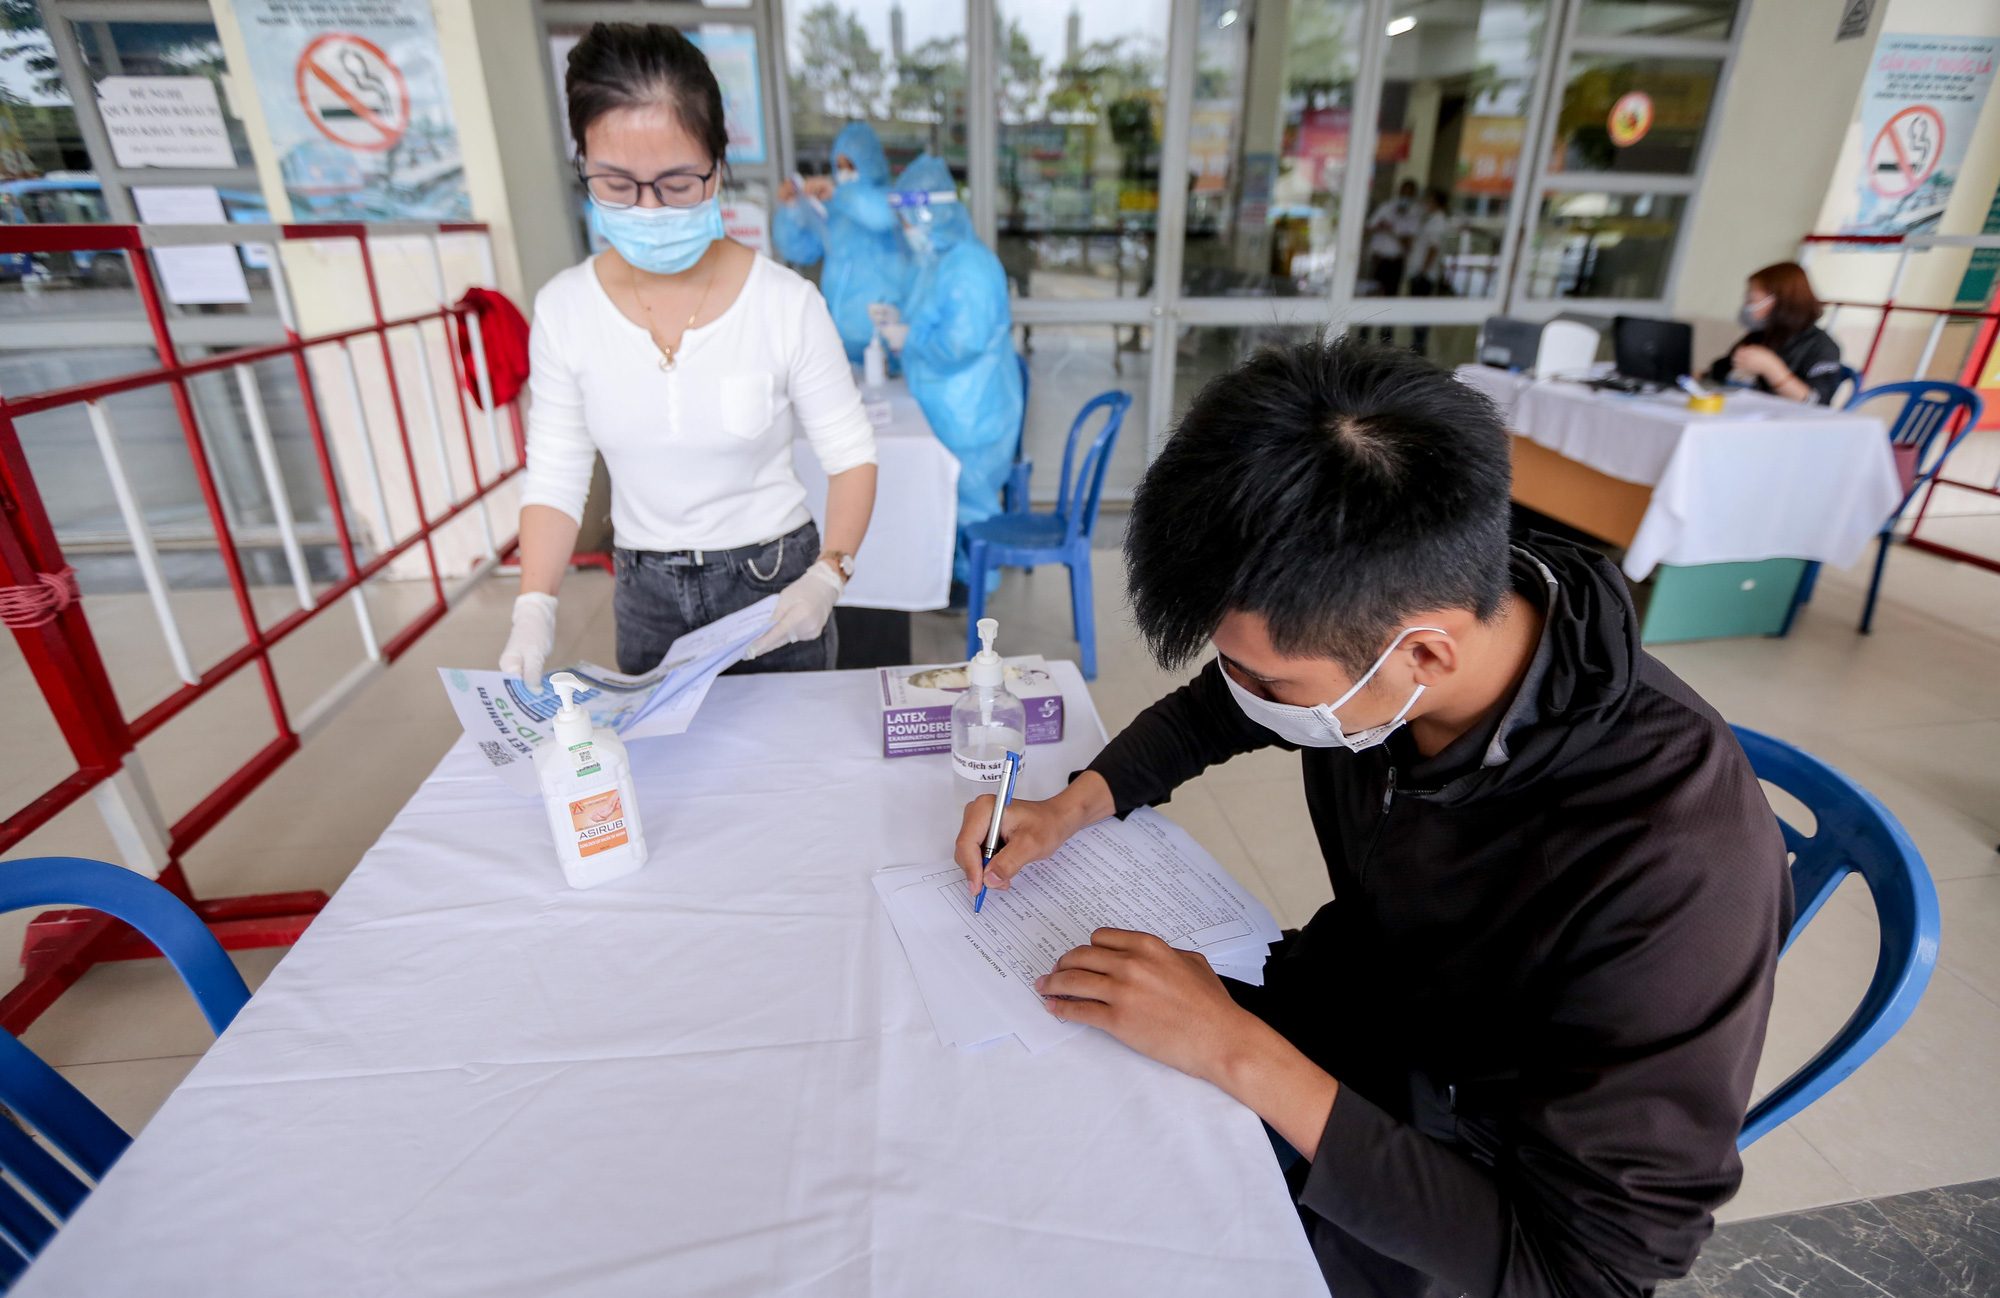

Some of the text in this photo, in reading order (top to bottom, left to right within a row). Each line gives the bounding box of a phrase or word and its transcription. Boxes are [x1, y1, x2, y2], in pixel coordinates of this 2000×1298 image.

[494, 697, 544, 747] ID-19
[886, 711, 927, 724] LATEX
[887, 722, 952, 736] POWDERE
[888, 734, 935, 742] EXAMINATION
[968, 761, 986, 771] dịch
[579, 820, 624, 840] ASIRUB
